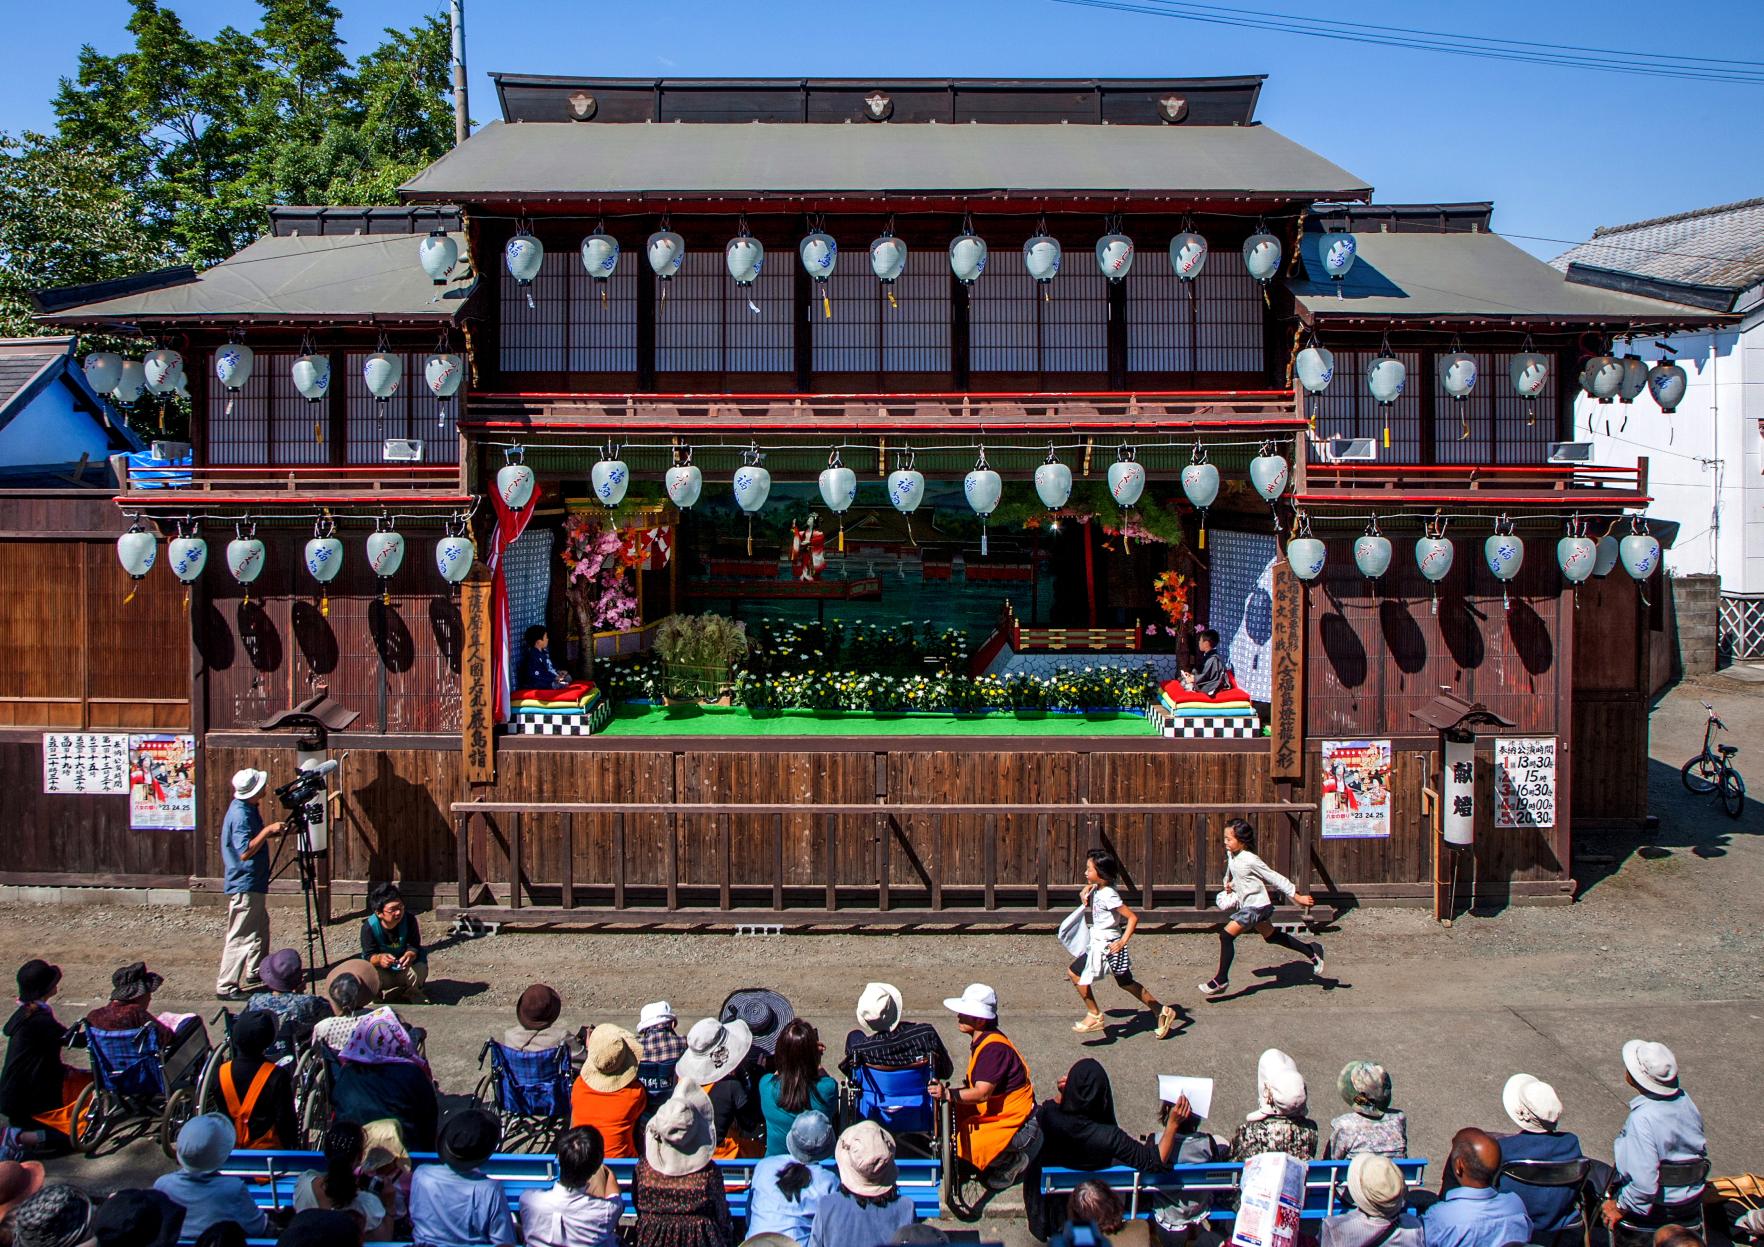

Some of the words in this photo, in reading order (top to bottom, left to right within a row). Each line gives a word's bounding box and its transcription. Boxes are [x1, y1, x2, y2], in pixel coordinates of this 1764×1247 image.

[599, 467, 625, 498] 福島
[174, 547, 202, 574] 福島
[309, 545, 333, 573] 福島
[439, 545, 462, 574] 福島
[1490, 544, 1516, 572] 福島
[1453, 761, 1473, 818] 献燈
